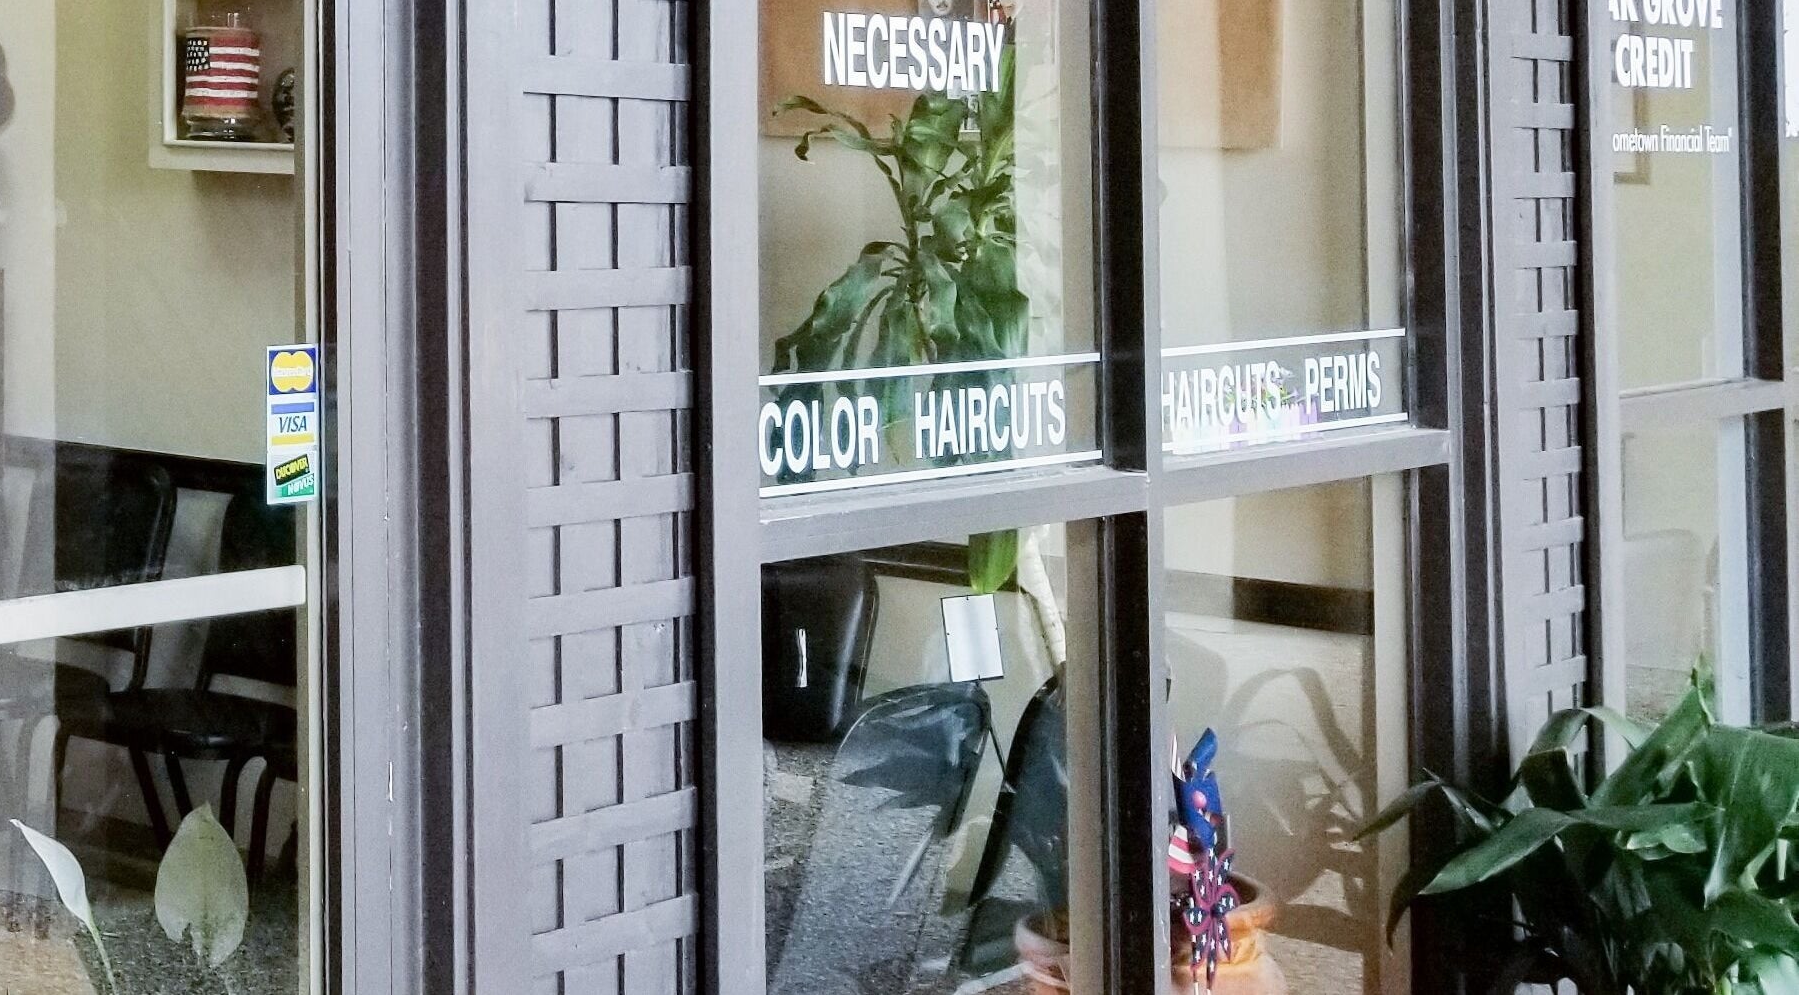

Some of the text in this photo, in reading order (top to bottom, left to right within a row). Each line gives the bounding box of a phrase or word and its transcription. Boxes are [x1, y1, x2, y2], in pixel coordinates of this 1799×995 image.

[823, 11, 1004, 92] NECESSARY
[1615, 34, 1694, 88] CREDIT
[1660, 124, 1703, 152] Financial
[1161, 351, 1381, 433] HAIRCUTS PERMS
[279, 416, 307, 433] VISA
[759, 380, 1066, 476] COLOR HAIRCUTS
[275, 456, 308, 481] DISCOVER
